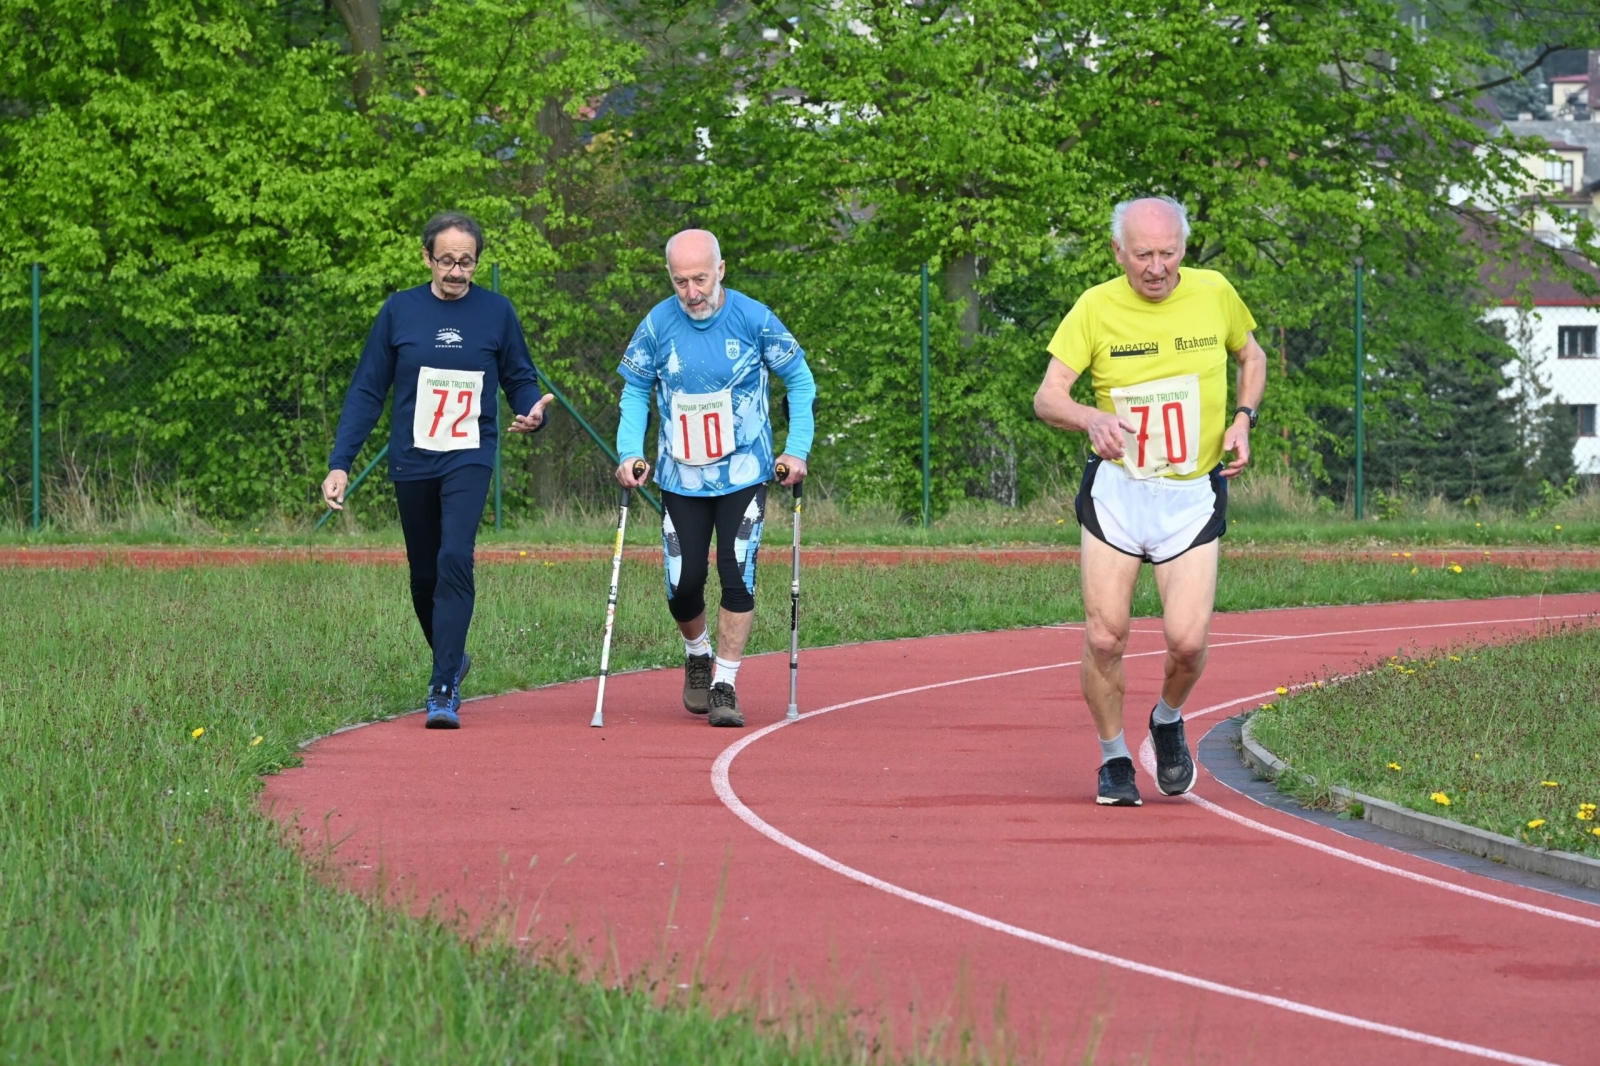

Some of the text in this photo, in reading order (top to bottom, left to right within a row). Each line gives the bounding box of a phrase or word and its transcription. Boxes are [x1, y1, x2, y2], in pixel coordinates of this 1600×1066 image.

[1110, 341, 1159, 353] MARATON
[426, 378, 477, 389] PIVOVAR TRUTNOV
[1125, 390, 1189, 405] PIVOVAR TRUTNOV
[428, 389, 473, 438] 72
[677, 401, 724, 412] PIVOVAR TRUTNOV
[679, 412, 723, 460] 10
[1130, 402, 1187, 468] 70
